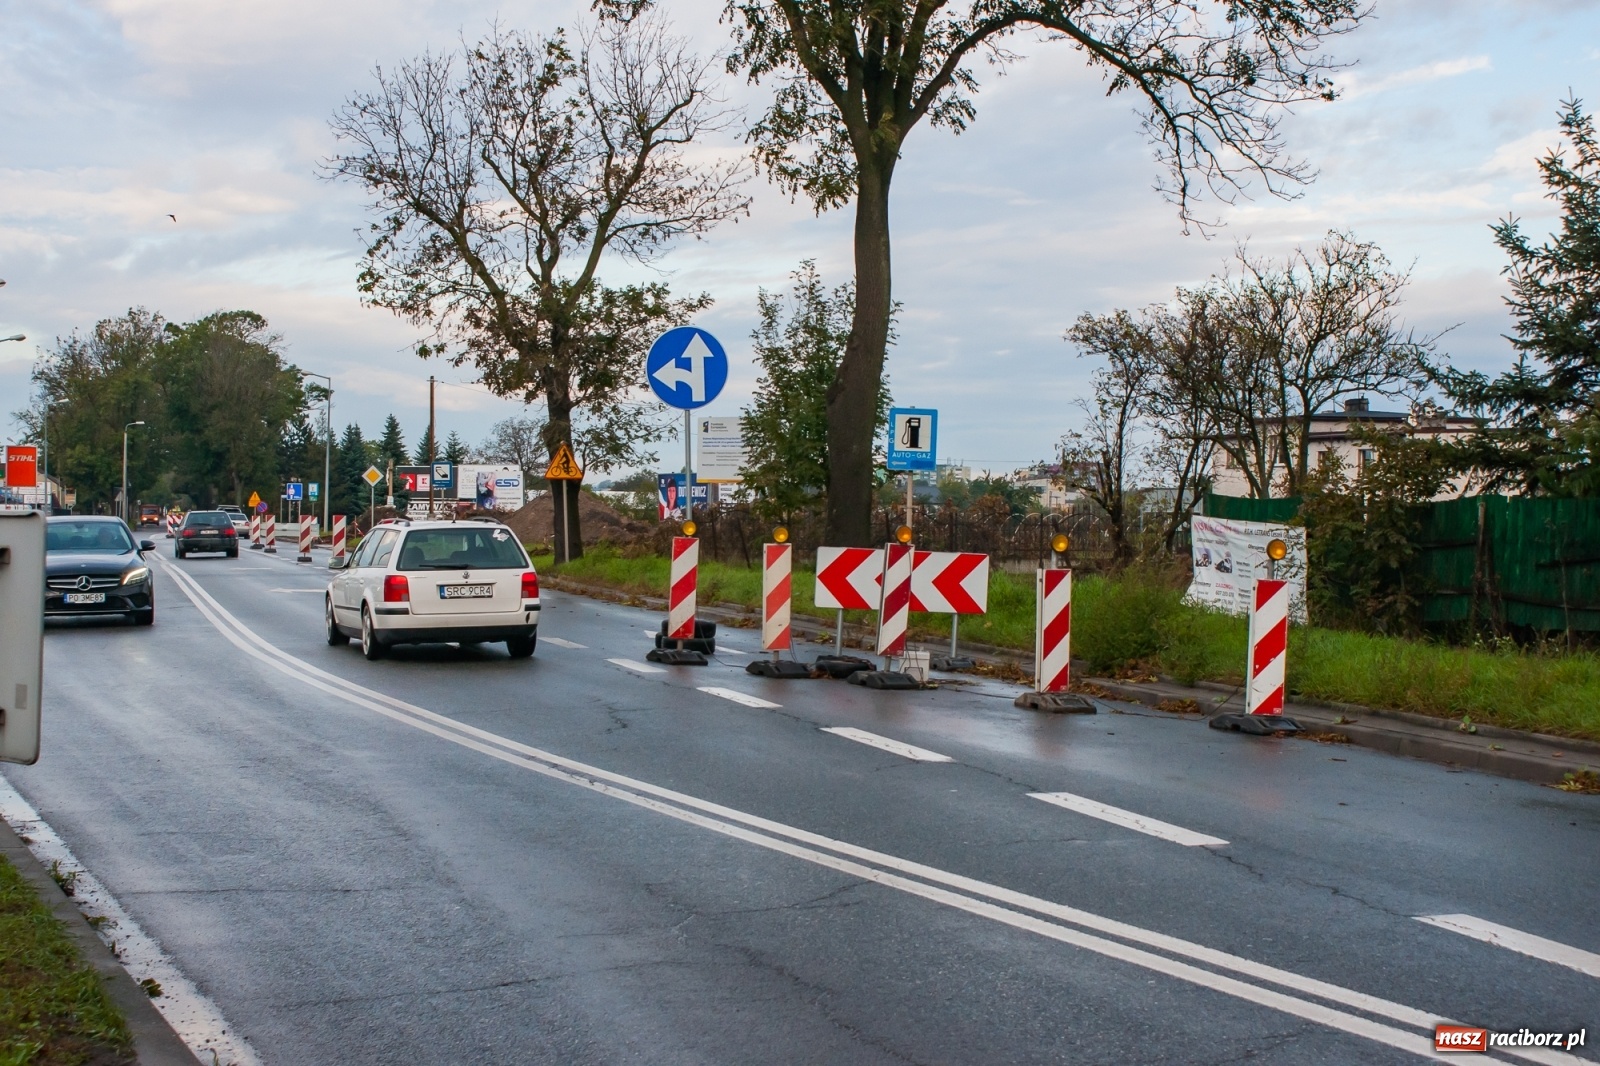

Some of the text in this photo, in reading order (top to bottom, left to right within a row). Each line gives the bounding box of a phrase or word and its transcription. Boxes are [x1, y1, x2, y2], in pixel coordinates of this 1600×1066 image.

[495, 478, 520, 487] ESD
[446, 586, 492, 596] SRC 9CR4
